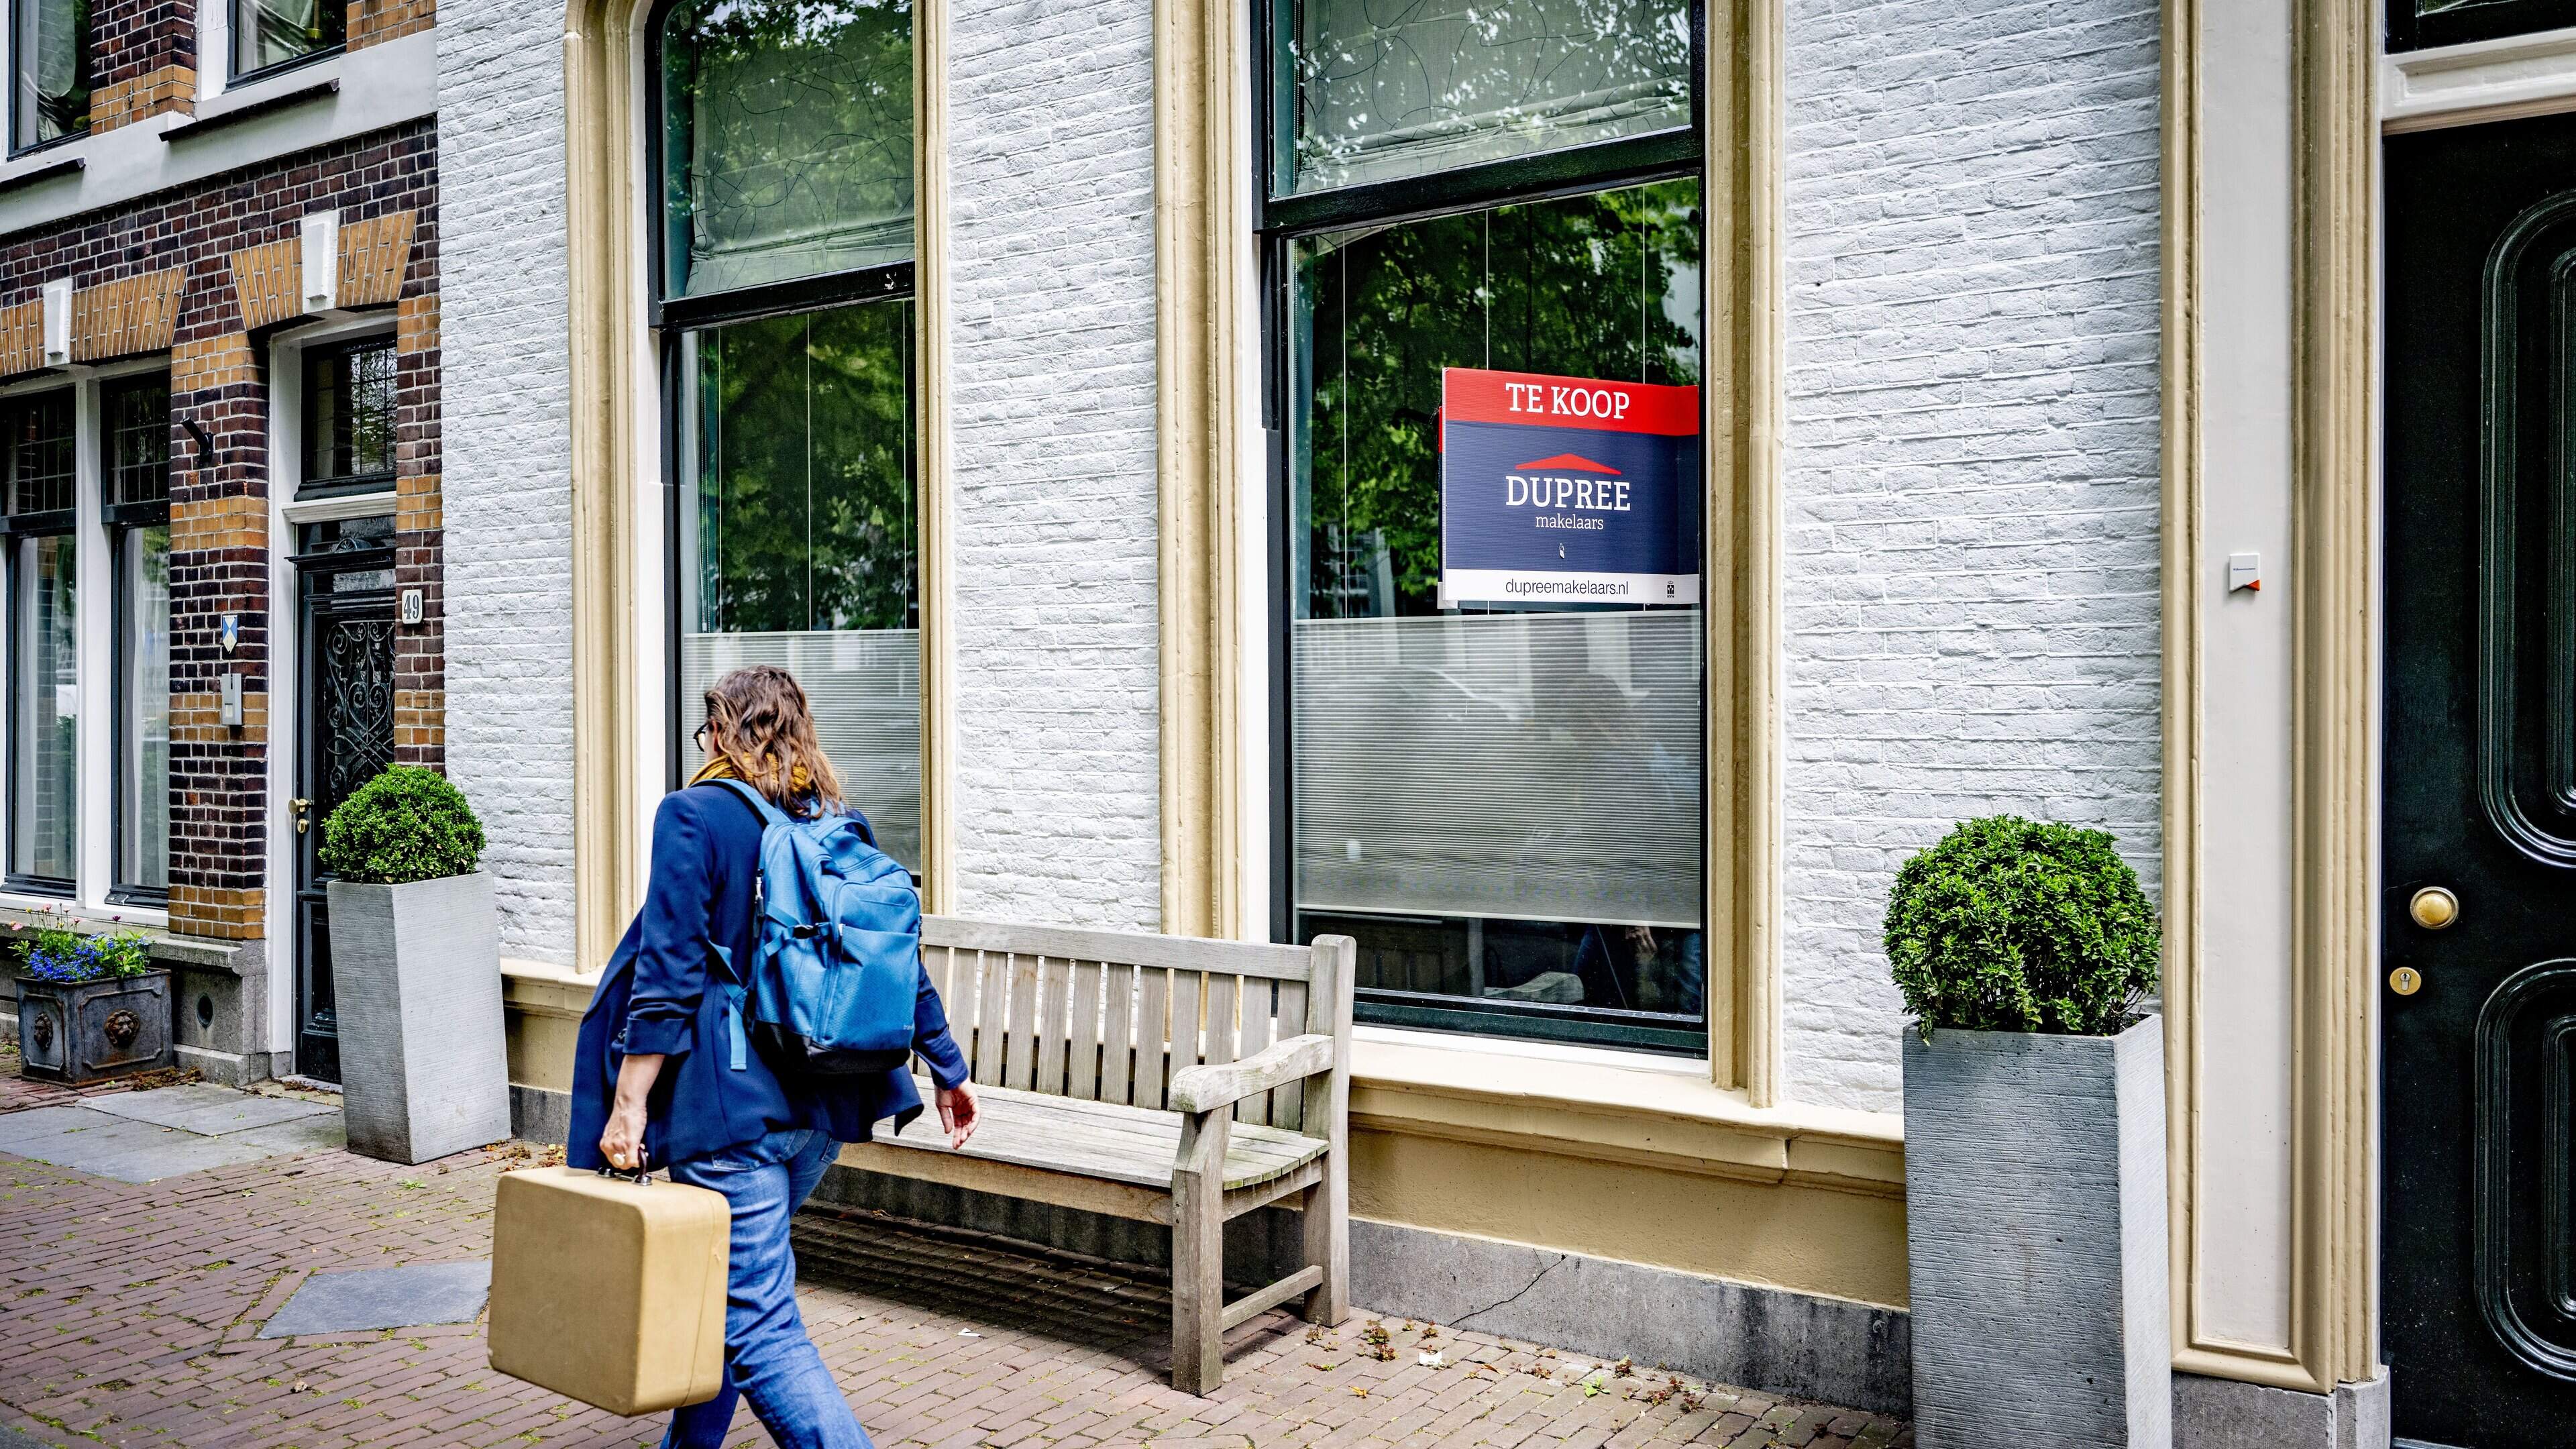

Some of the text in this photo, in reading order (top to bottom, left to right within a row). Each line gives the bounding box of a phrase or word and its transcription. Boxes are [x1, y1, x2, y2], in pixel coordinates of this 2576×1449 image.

[1505, 382, 1630, 419] TE KOOP
[1505, 476, 1631, 511] DUPREE
[1535, 513, 1604, 530] makelaars
[1505, 578, 1629, 596] dupreemakelaars.nl
[403, 594, 420, 620] 49
